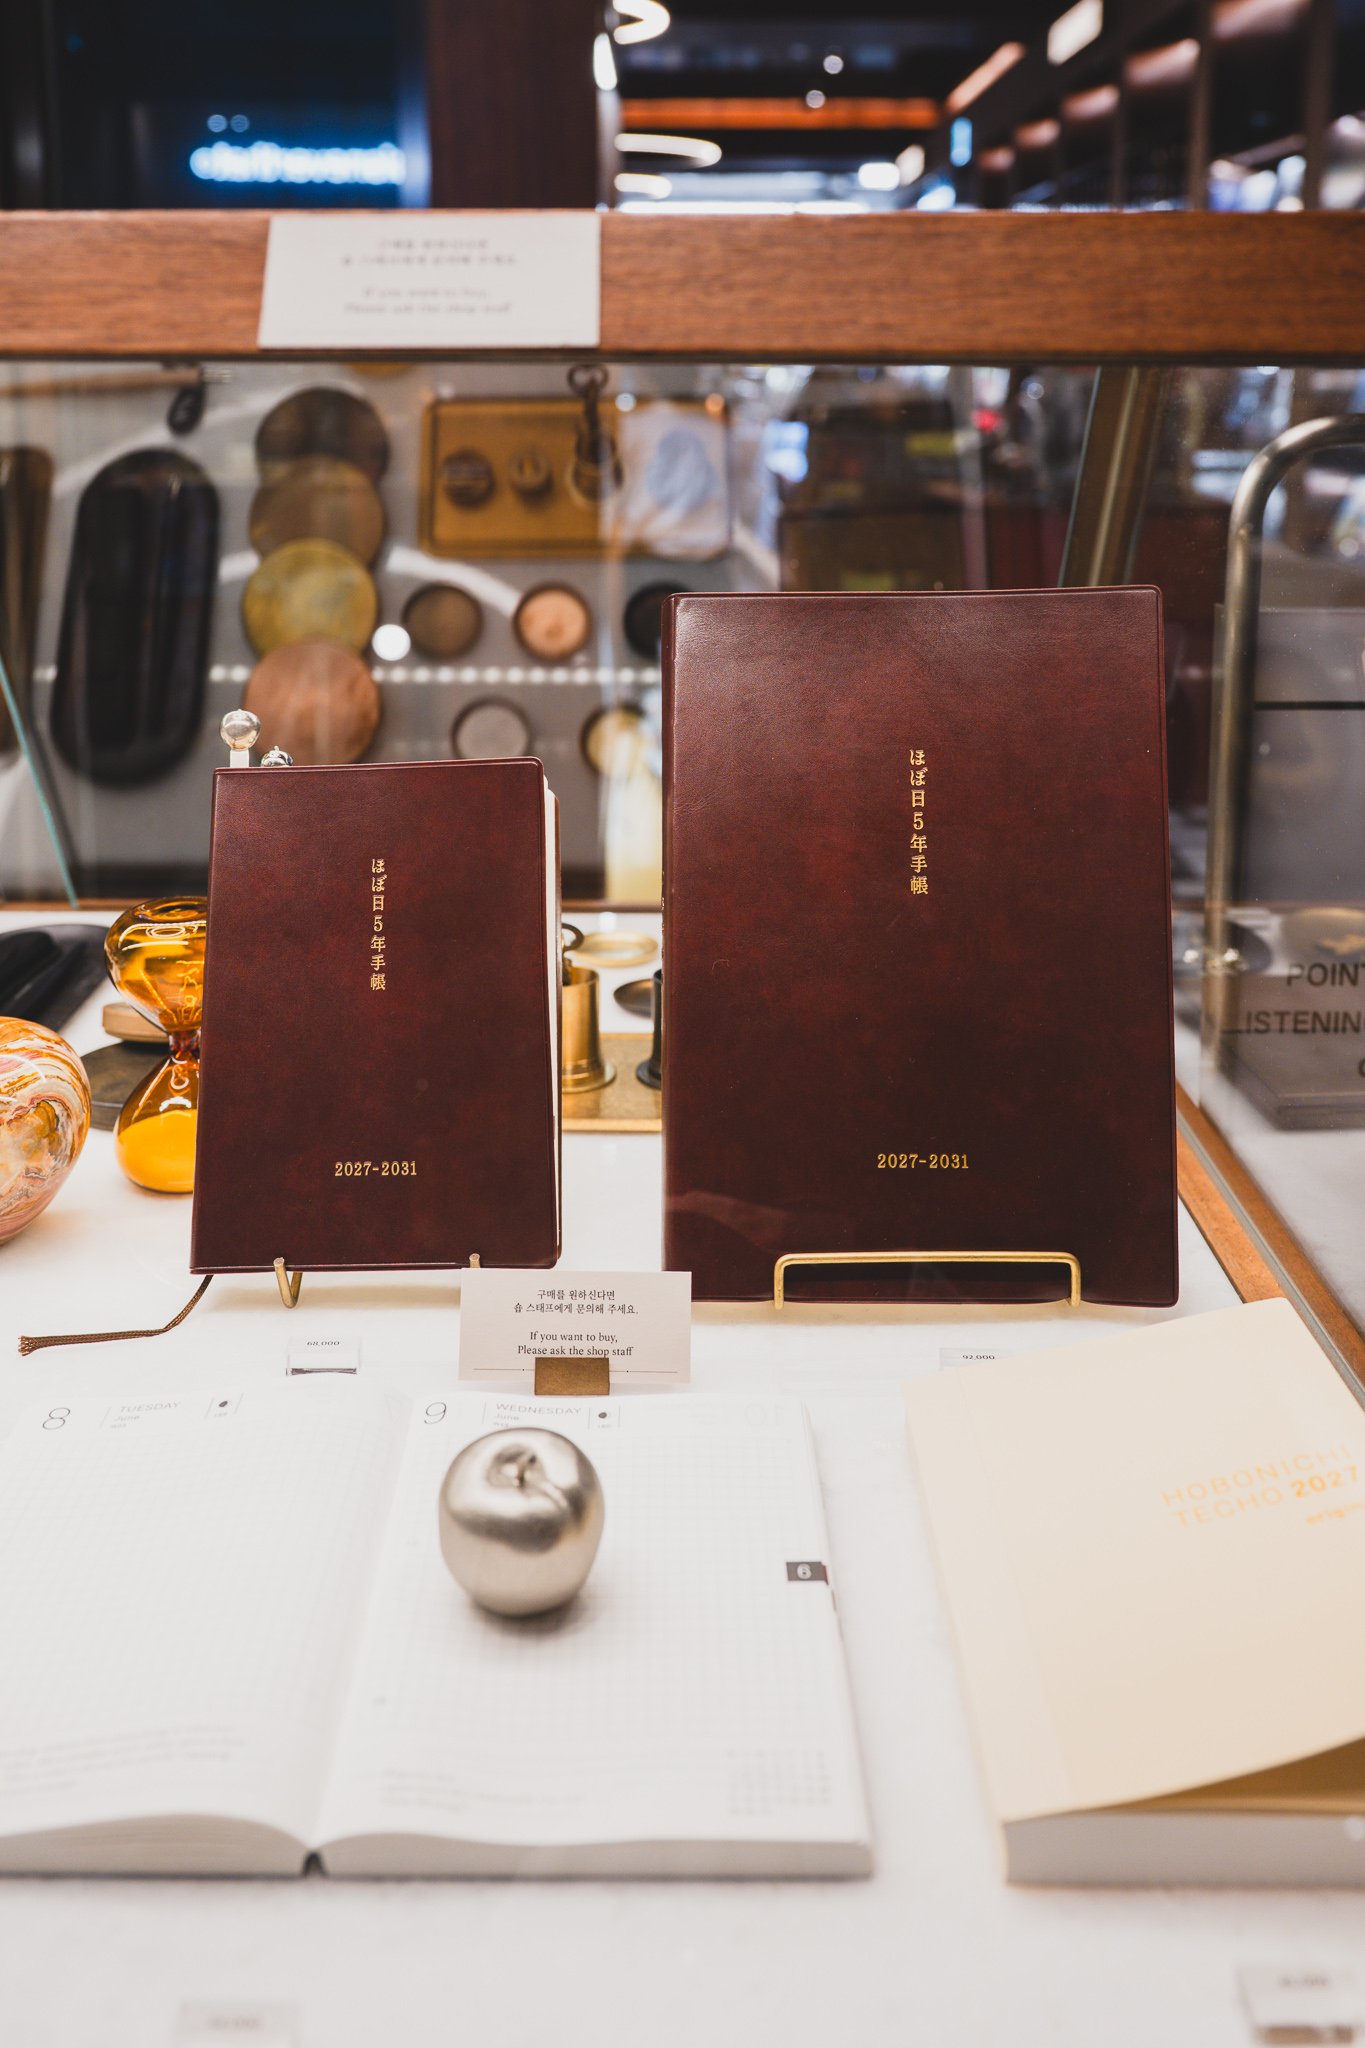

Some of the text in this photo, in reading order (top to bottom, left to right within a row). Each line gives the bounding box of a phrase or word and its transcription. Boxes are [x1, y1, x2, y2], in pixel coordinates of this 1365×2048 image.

[1230, 1010, 1365, 1035] ISTENIN
[335, 1160, 417, 1177] 2027-2031
[877, 1153, 969, 1169] 2027-2031
[537, 1289, 616, 1301] 구매를 원하신다면
[526, 1302, 573, 1314] 스태프에게
[576, 1303, 604, 1315] 문의해
[530, 1331, 618, 1344] If you want to buy,
[517, 1345, 634, 1358] Please ask the shop staff
[423, 1401, 448, 1425] 9
[496, 1402, 582, 1415] WEDNESDAY
[42, 1406, 71, 1430] 8
[796, 1563, 812, 1580] 6
